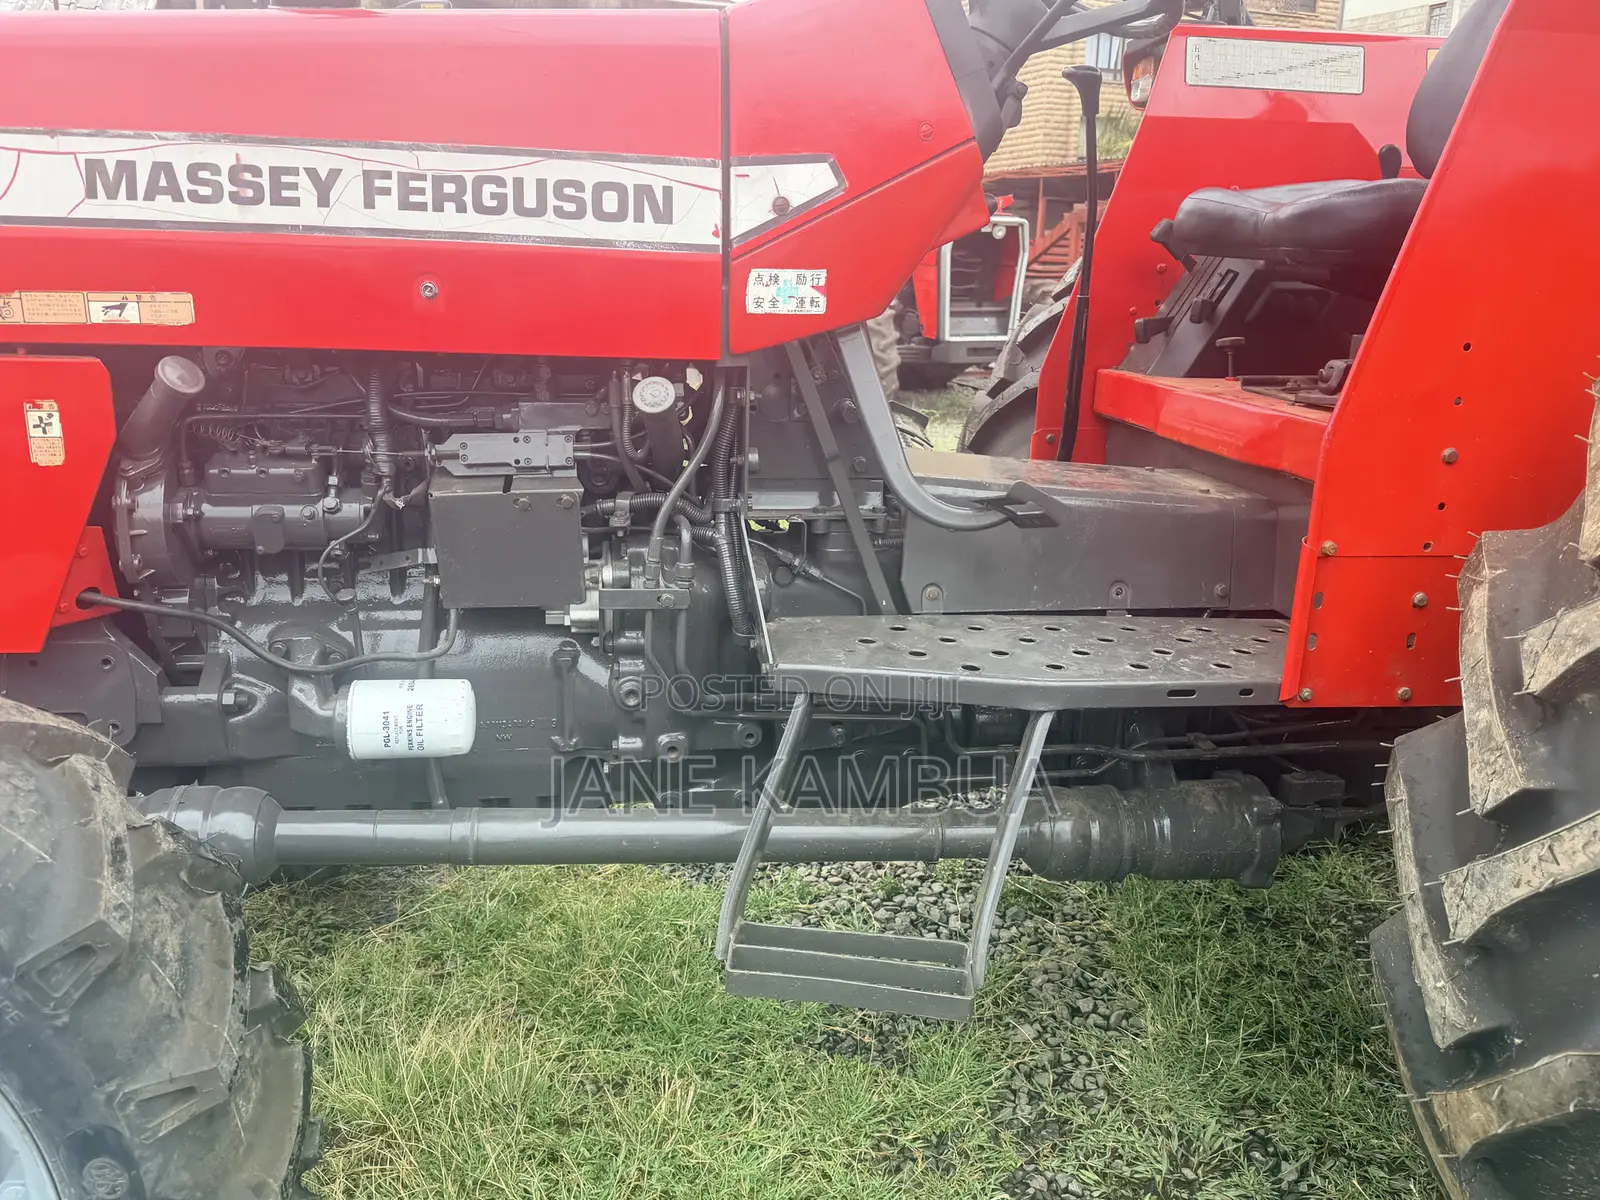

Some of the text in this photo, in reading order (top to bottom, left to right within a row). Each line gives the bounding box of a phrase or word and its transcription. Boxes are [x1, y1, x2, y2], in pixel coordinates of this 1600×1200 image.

[84, 158, 675, 225] MASSEY FERGUSON
[753, 272, 822, 286] 点検 励行
[753, 294, 821, 309] 安全 運転
[382, 711, 391, 748] PGL-3041
[406, 729, 415, 751] PERKINS
[415, 703, 425, 752] OIL FILTER
